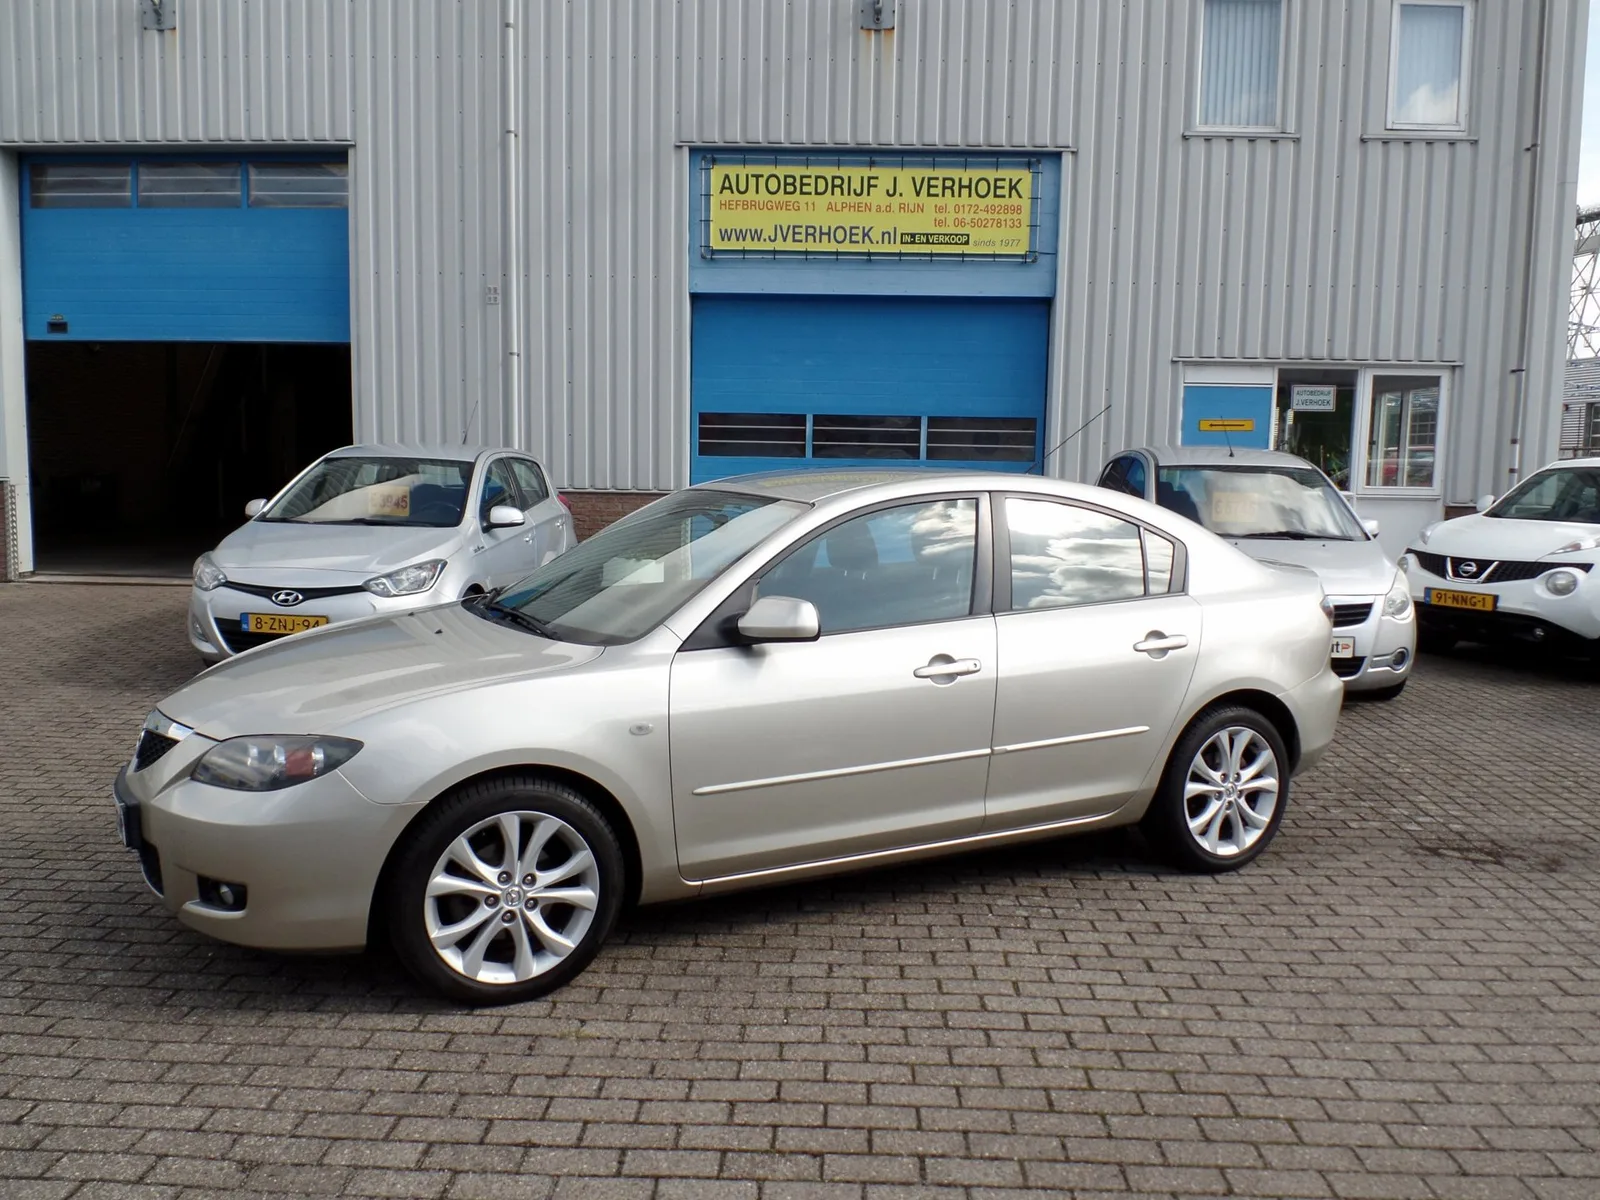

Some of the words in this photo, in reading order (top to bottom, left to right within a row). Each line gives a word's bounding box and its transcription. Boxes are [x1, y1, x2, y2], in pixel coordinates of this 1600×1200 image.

[719, 173, 879, 197] AUTOBEDRIJF
[886, 176, 903, 198] J.
[911, 176, 1023, 199] VERHOEK
[719, 200, 800, 211] HEFBRUGWEG
[805, 201, 816, 212] 11
[826, 201, 872, 213] ALPHEN
[875, 203, 895, 213] a.d.
[898, 203, 925, 213] RIJN
[934, 203, 950, 214] tel.
[954, 204, 1022, 215] 0172-492898
[933, 217, 950, 228] tel.
[953, 218, 1022, 229] 06-50278133
[719, 224, 897, 245] www.JVERHOEK.nl
[902, 234, 914, 243] IN-
[915, 234, 929, 243] EN
[929, 234, 968, 244] VERKOOP
[973, 237, 996, 247] sinds
[1000, 238, 1021, 247] 1977
[1435, 592, 1487, 608] 91-NNG-1
